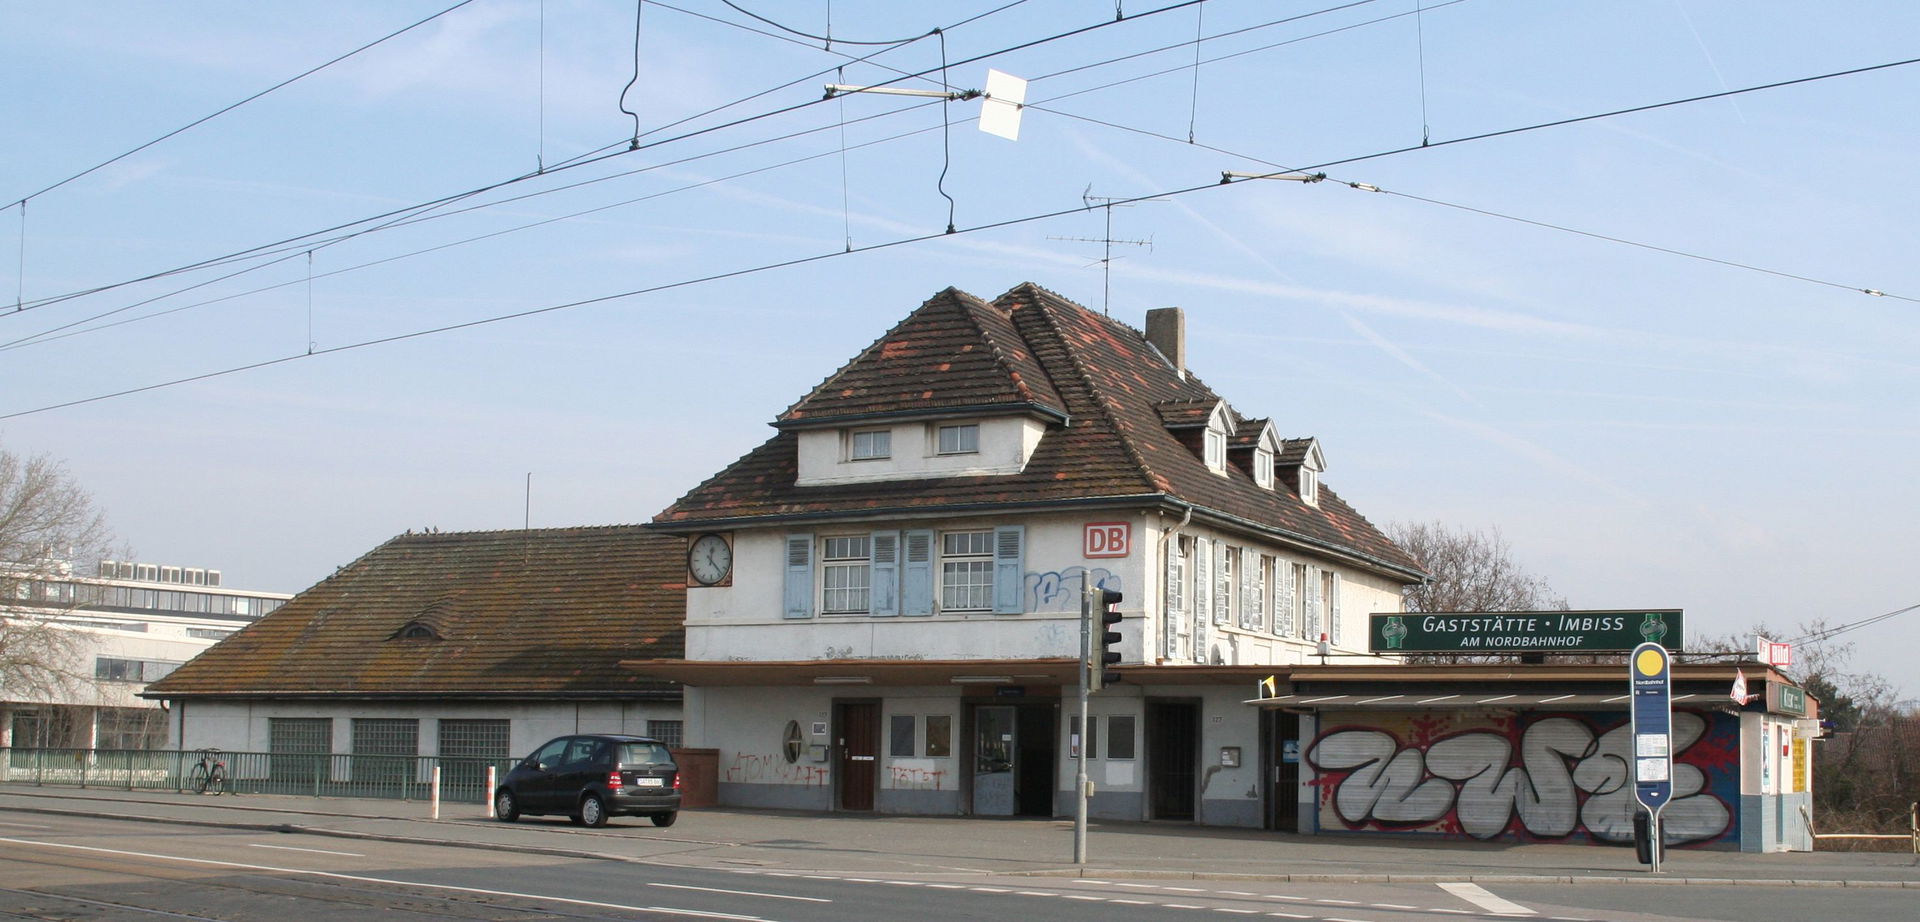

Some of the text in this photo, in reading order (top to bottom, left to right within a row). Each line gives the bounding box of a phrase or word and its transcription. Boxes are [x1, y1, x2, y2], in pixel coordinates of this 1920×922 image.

[1089, 527, 1124, 552] DB
[1422, 615, 1624, 632] GASTSTÄTTE IMBISS
[1460, 635, 1584, 647] AM NORDBAHNHOF
